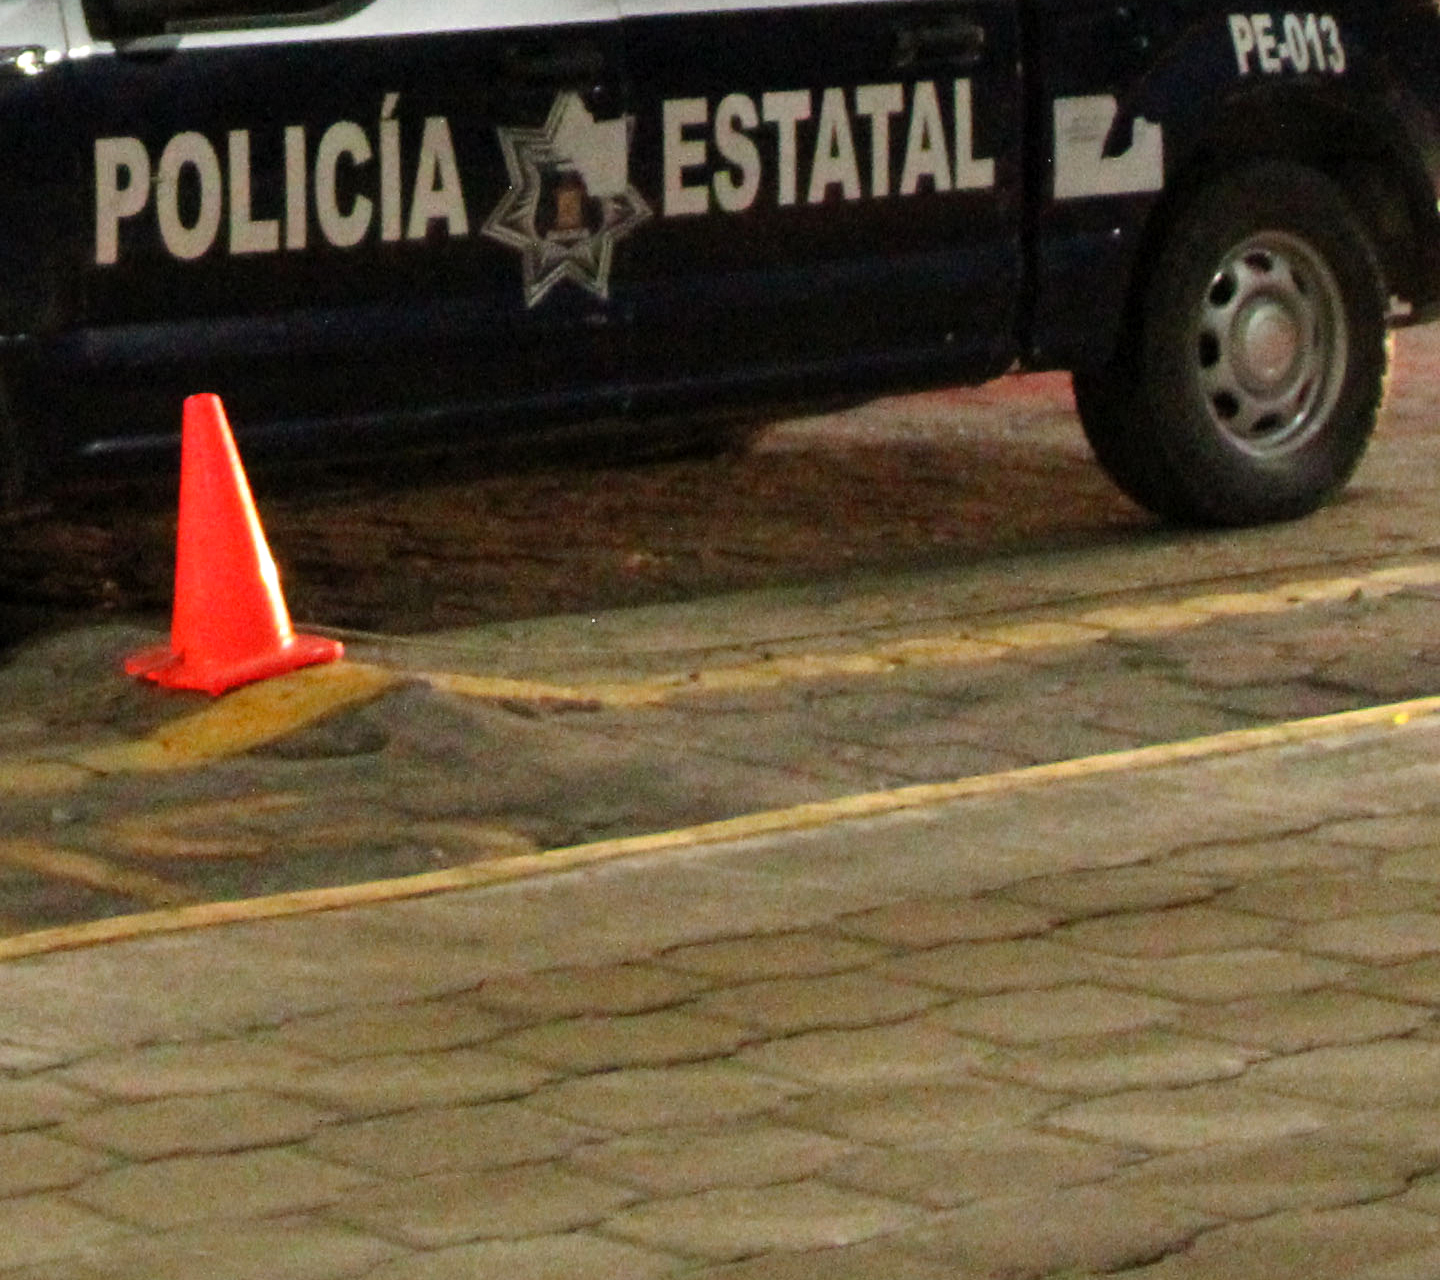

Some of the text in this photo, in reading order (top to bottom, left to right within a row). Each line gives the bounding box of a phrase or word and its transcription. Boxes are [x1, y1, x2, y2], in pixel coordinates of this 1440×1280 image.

[1228, 12, 1347, 74] PE-013
[93, 76, 996, 265] POLICÍA ESTATAL
